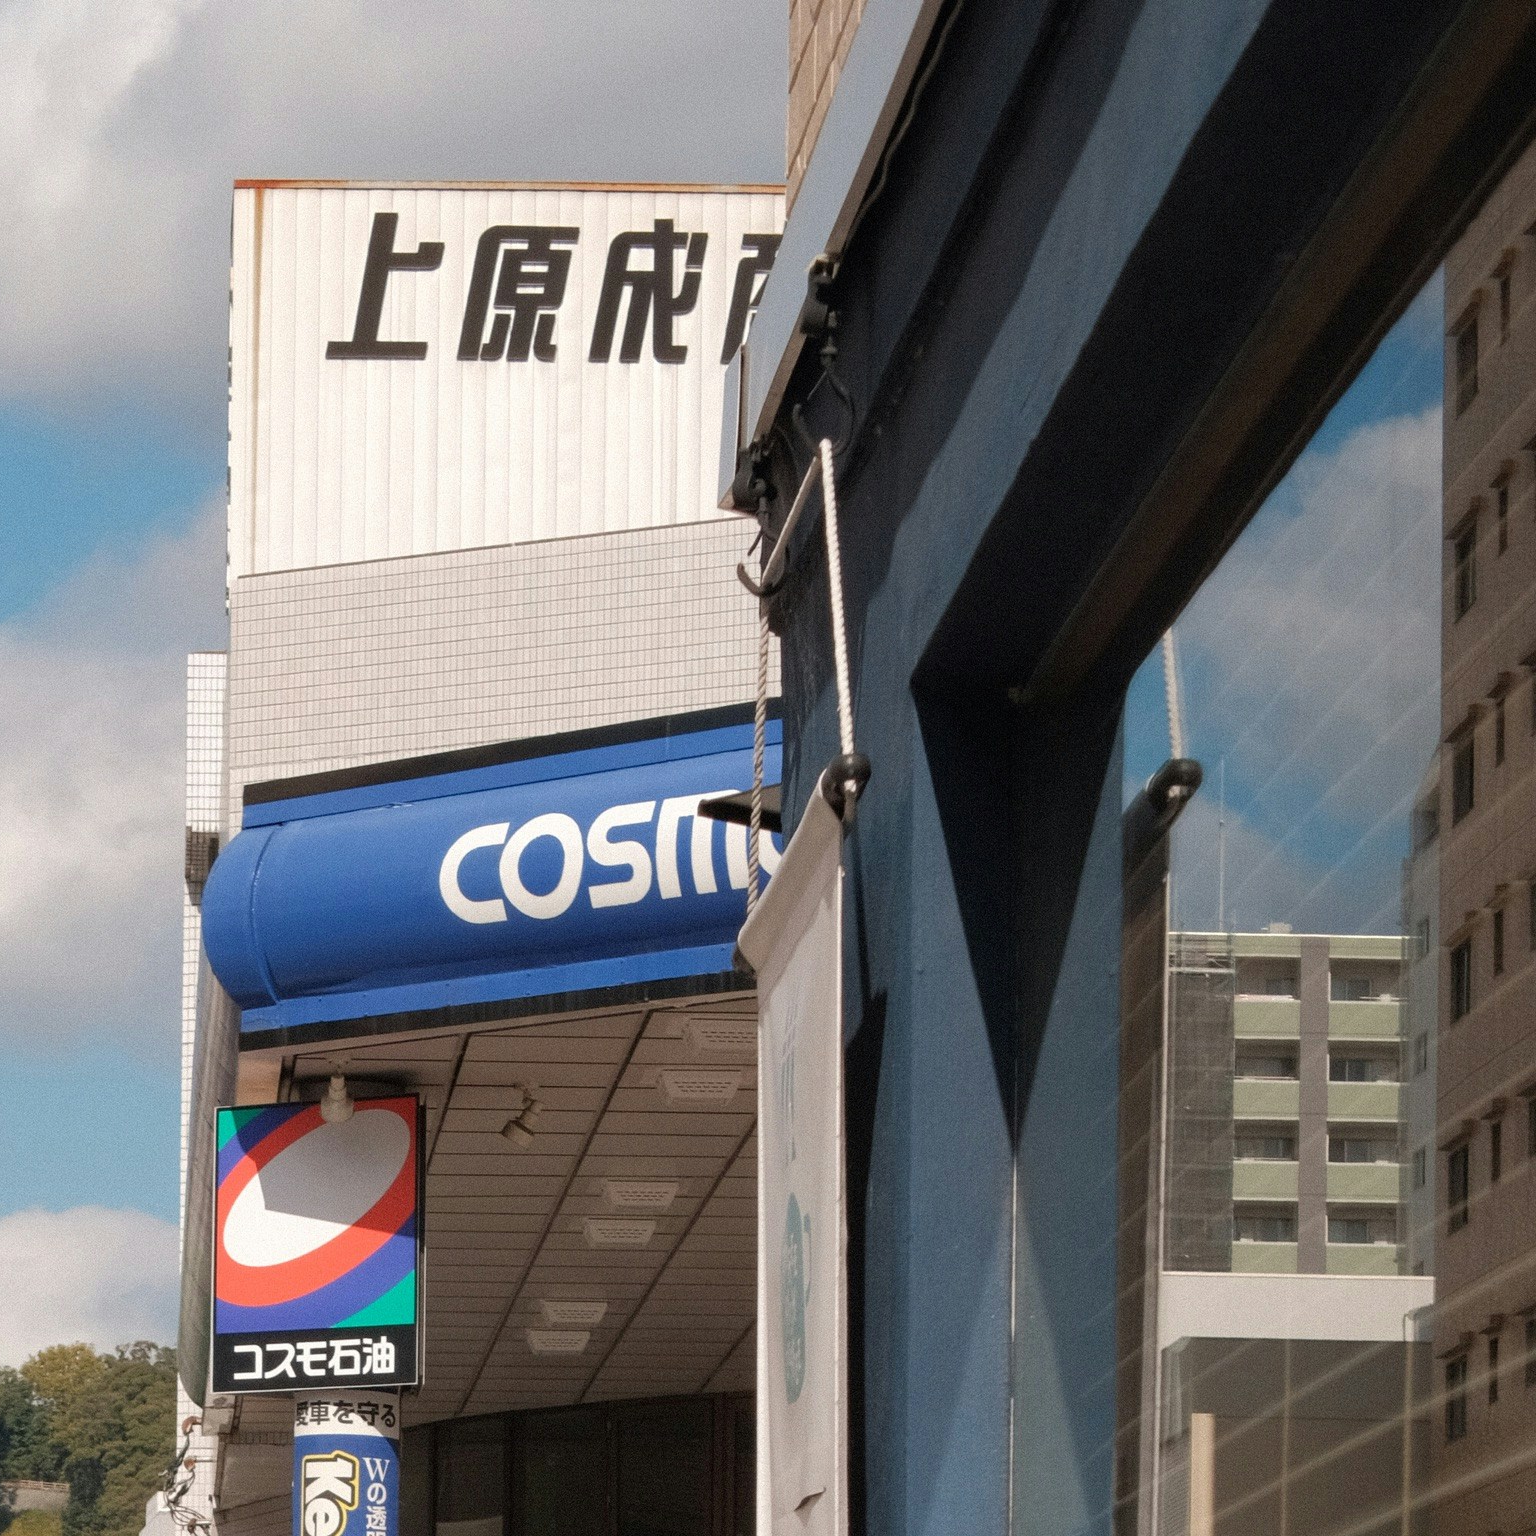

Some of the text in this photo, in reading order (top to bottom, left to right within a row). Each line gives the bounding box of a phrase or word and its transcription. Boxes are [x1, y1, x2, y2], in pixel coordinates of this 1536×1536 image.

[438, 789, 781, 924] COSM
[233, 1337, 395, 1381] コスモ石油
[296, 1401, 396, 1427] 愛車を守る
